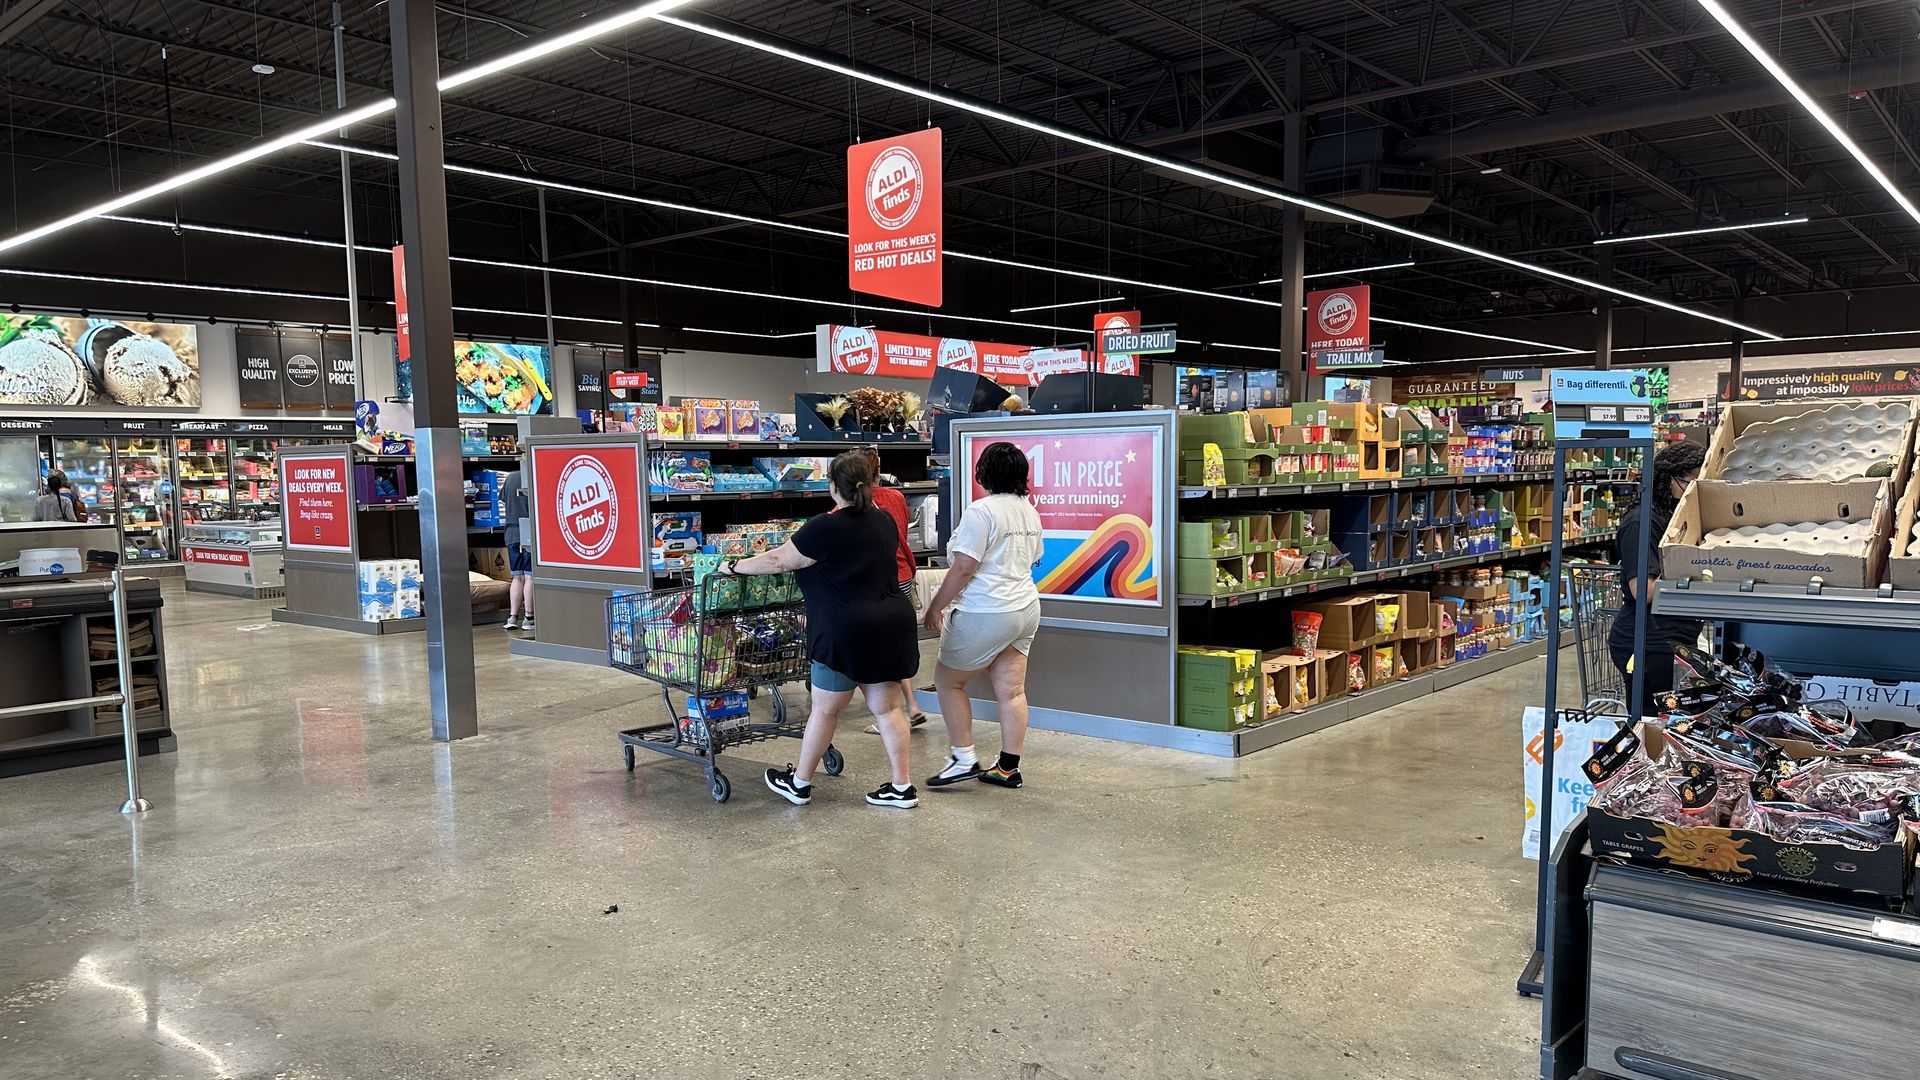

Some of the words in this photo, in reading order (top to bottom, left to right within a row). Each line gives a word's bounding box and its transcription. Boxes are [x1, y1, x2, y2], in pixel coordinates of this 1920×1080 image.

[879, 166, 908, 193] ALDI
[882, 187, 910, 211] finds
[854, 242, 873, 253] LOOK
[875, 239, 889, 250] FOR
[891, 236, 907, 248] THIS
[909, 233, 936, 246] WEEK'S
[854, 258, 874, 272] RED
[877, 254, 896, 268] HOT
[900, 250, 936, 266] DEALS!
[1327, 303, 1346, 316] ALDI
[1329, 313, 1348, 325] finds
[842, 335, 865, 350] ALDI
[1108, 336, 1138, 350] DRIED
[1140, 333, 1170, 349] FRUIT
[1335, 337, 1364, 346] TODAY
[885, 344, 913, 356] LIMITED
[915, 347, 932, 358] TIME
[947, 347, 967, 361] ALDI
[248, 358, 269, 369] HIGH
[846, 352, 869, 367] finds
[984, 354, 1000, 363] HERE
[1001, 355, 1020, 365] TODAY
[1327, 353, 1353, 364] TRAIL
[1355, 352, 1373, 363] MIX
[333, 360, 354, 372] LOW
[1111, 359, 1127, 372] ALDI
[242, 369, 276, 380] QUALITY
[582, 374, 599, 386] Big
[1503, 370, 1524, 380] NUTS
[1744, 374, 1812, 387] Impressively
[1813, 372, 1838, 384] high
[1842, 371, 1882, 383] quality
[1408, 381, 1496, 394] GUARANTEED
[1567, 381, 1583, 390] Bag
[1585, 380, 1628, 389] differentli.
[1776, 386, 1788, 396] at
[1790, 383, 1849, 396] impossibly
[1851, 384, 1872, 392] low
[462, 395, 476, 407] Up
[295, 469, 309, 480] LOOK
[311, 469, 322, 479] FOR
[323, 468, 336, 479] NEW
[1054, 461, 1071, 487] IN
[1078, 460, 1123, 487] PRICE
[289, 483, 305, 493] DEALS
[306, 482, 324, 493] EVERY
[325, 482, 344, 493] WEEK.
[570, 482, 600, 509] ALDI
[1034, 493, 1065, 509] years
[299, 498, 310, 507] Find
[576, 509, 605, 533] finds
[1691, 558, 1734, 566] world's
[1736, 559, 1771, 570] finest
[1774, 561, 1834, 573] avocados
[1837, 685, 1915, 708] TABLE
[1621, 843, 1644, 852] GRAPES
[1775, 846, 1819, 862] DULCINEA
